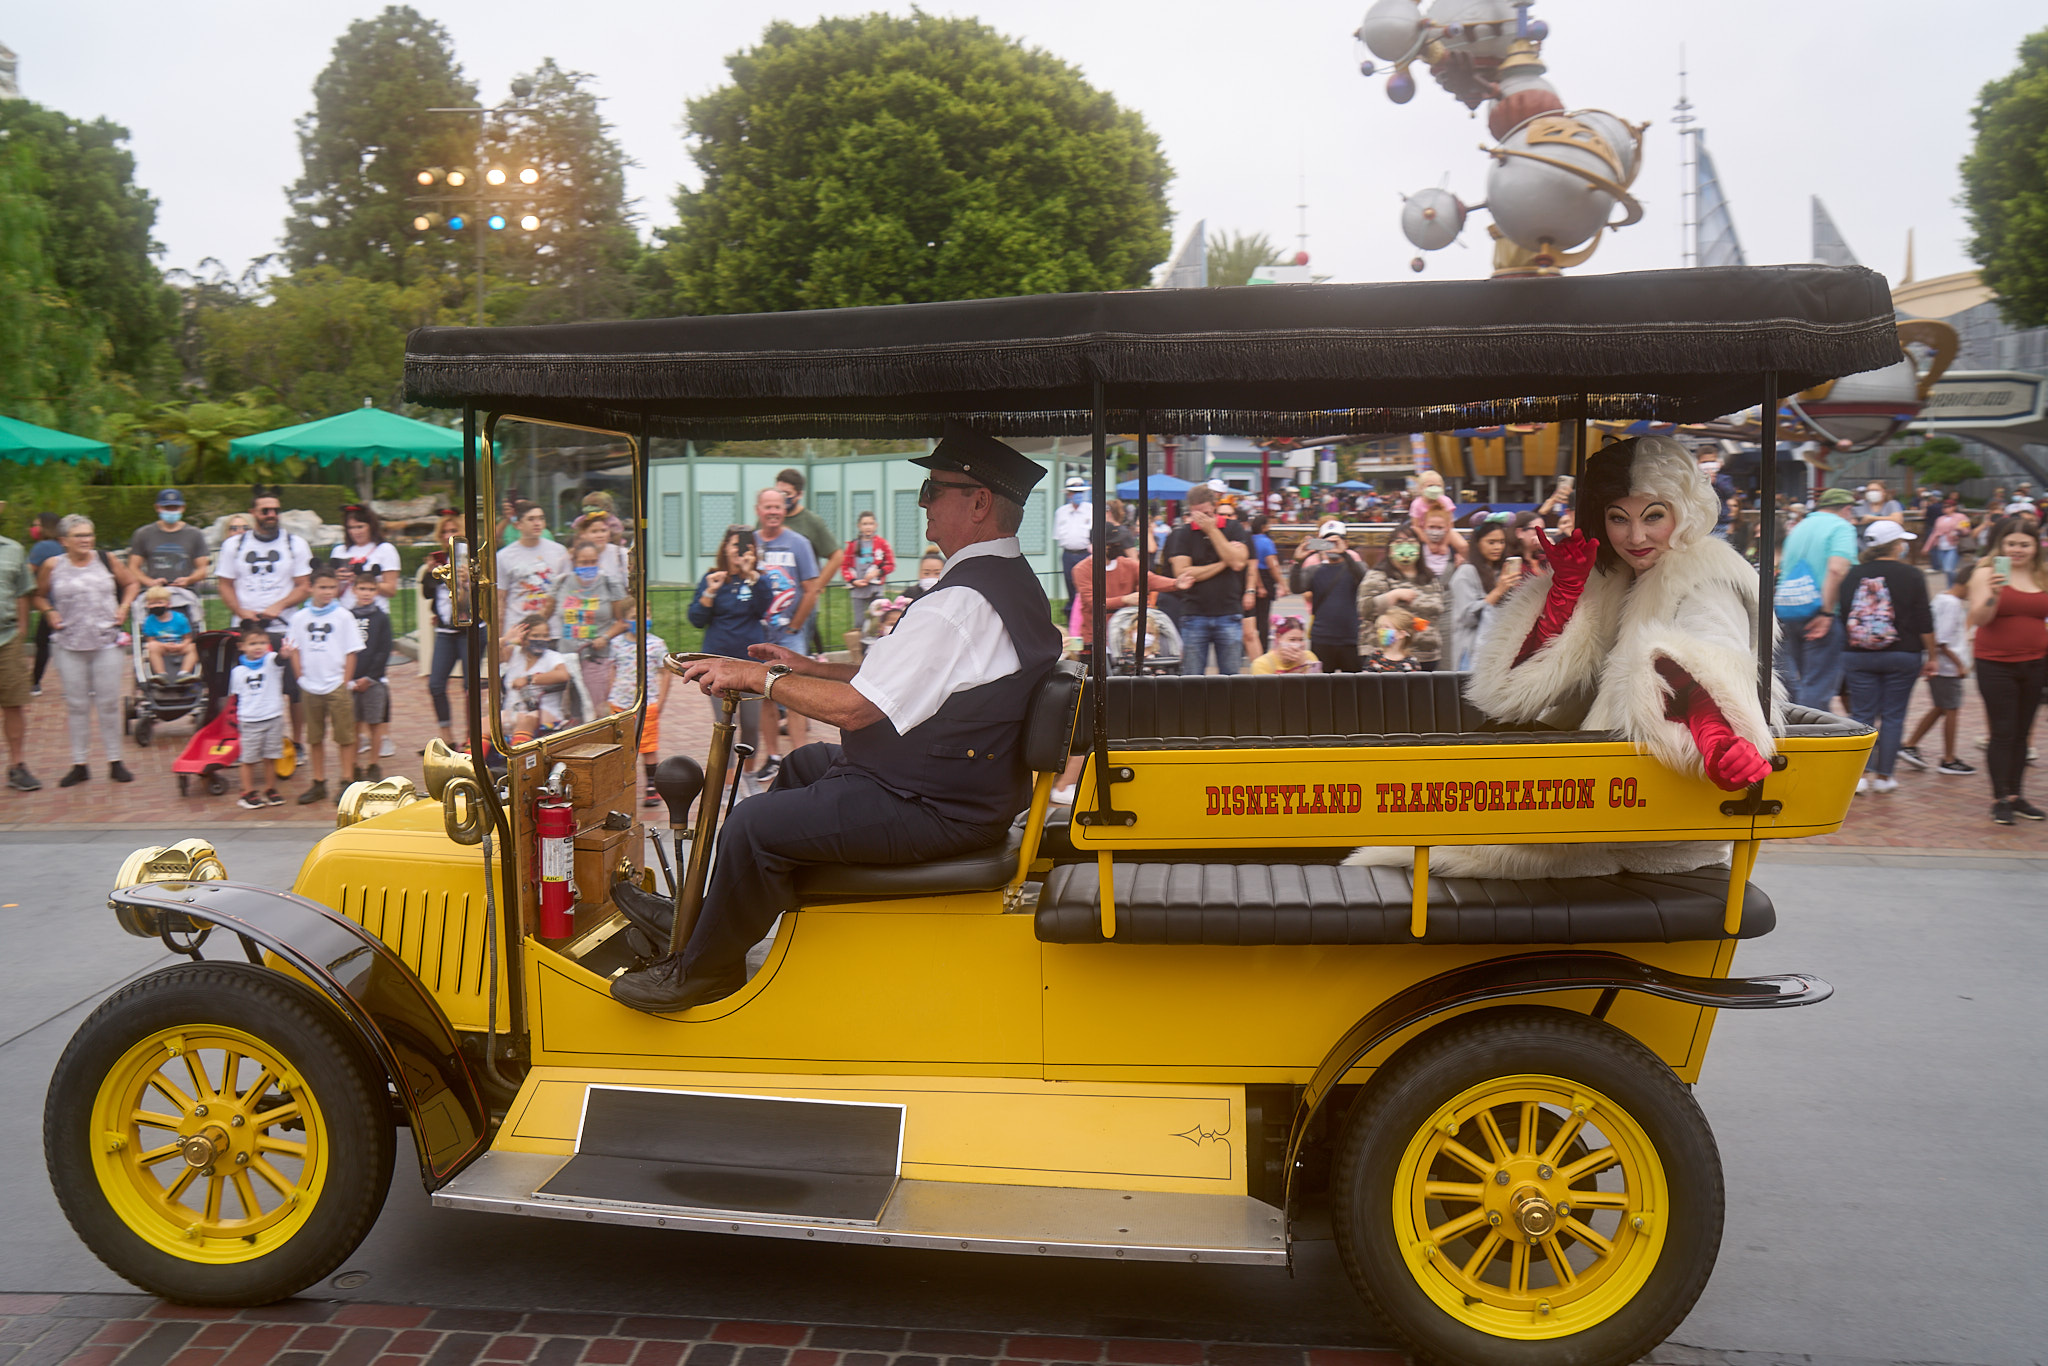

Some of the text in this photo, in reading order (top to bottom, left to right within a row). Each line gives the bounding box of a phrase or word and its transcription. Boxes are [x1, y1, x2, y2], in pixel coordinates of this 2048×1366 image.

[1205, 776, 1647, 816] DISNEYLAND TRANSPORTATION CO.
